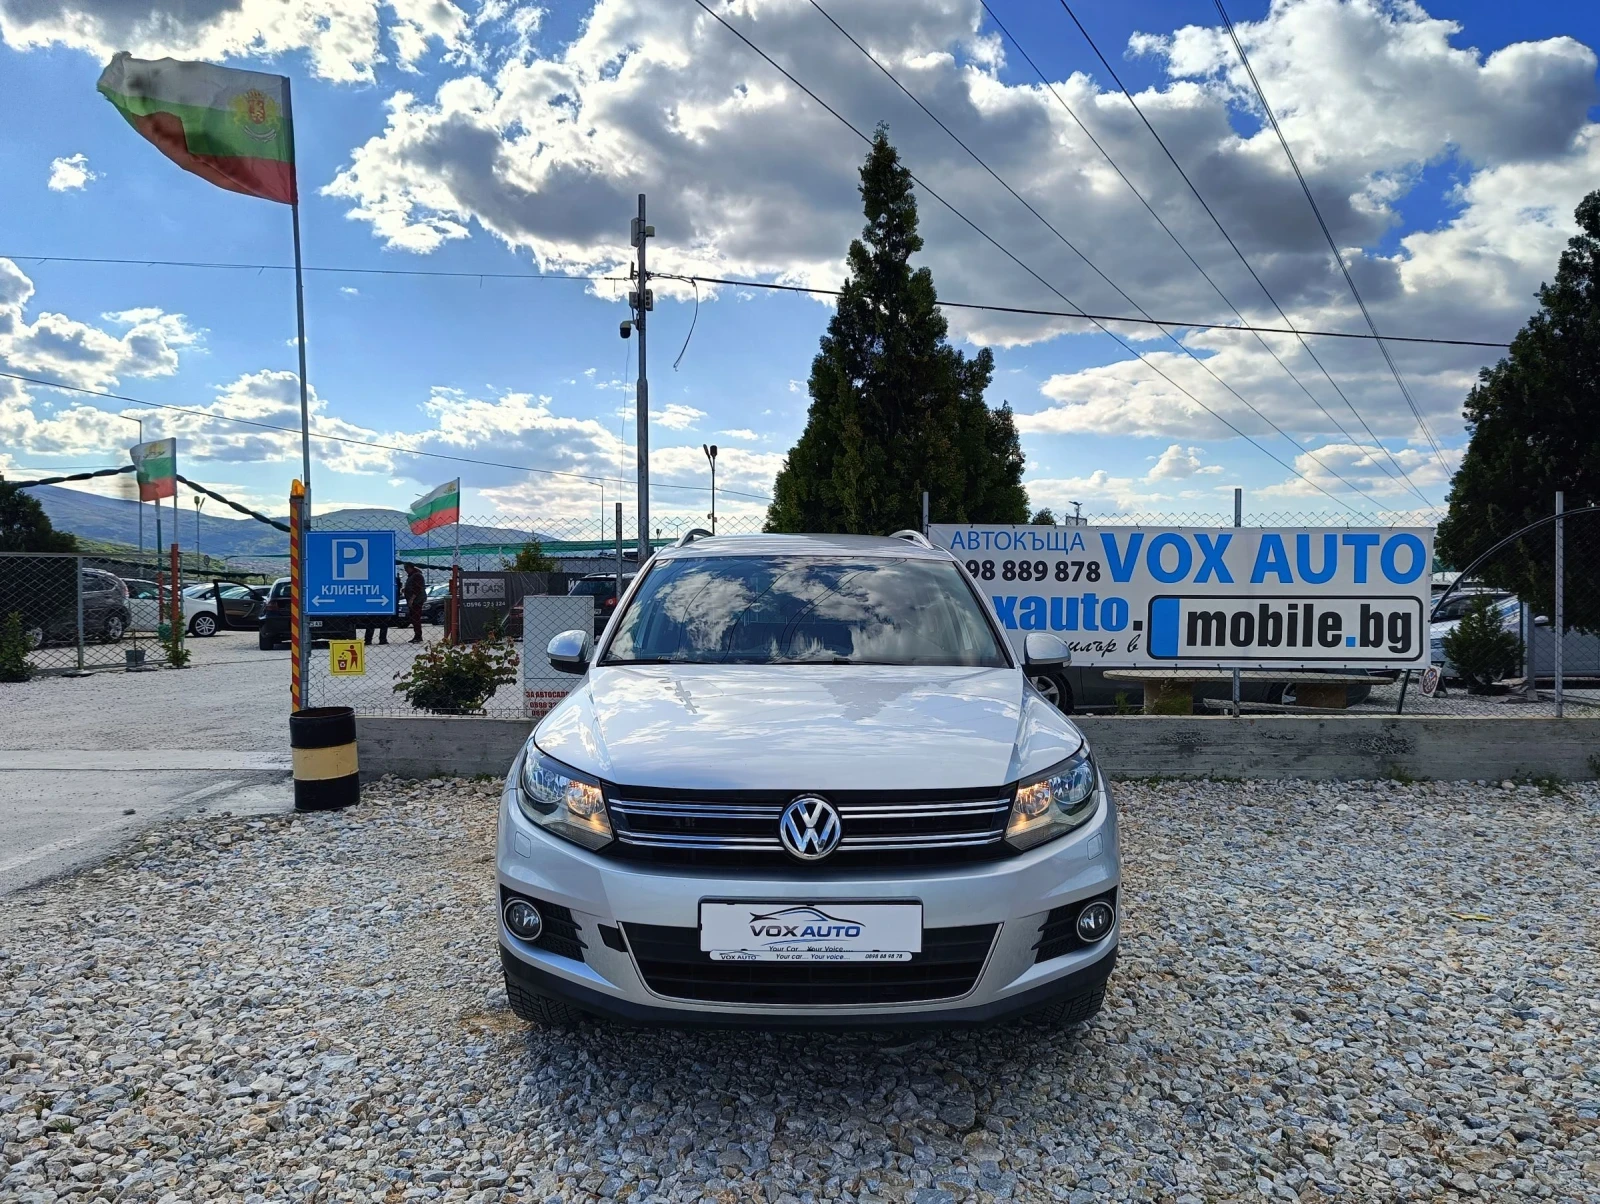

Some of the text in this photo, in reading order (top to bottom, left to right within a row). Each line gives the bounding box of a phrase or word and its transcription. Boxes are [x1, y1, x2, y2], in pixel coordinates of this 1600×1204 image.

[950, 531, 1086, 556] АВТОКЪЩА
[336, 541, 364, 578] P
[1100, 532, 1427, 585] VOX AUTO
[1001, 560, 1049, 582] 889
[1054, 560, 1101, 583] 878
[321, 585, 380, 596] КЛИЕНТИ
[1186, 603, 1412, 654] mobile.bg
[749, 925, 861, 938] VOX AUTO
